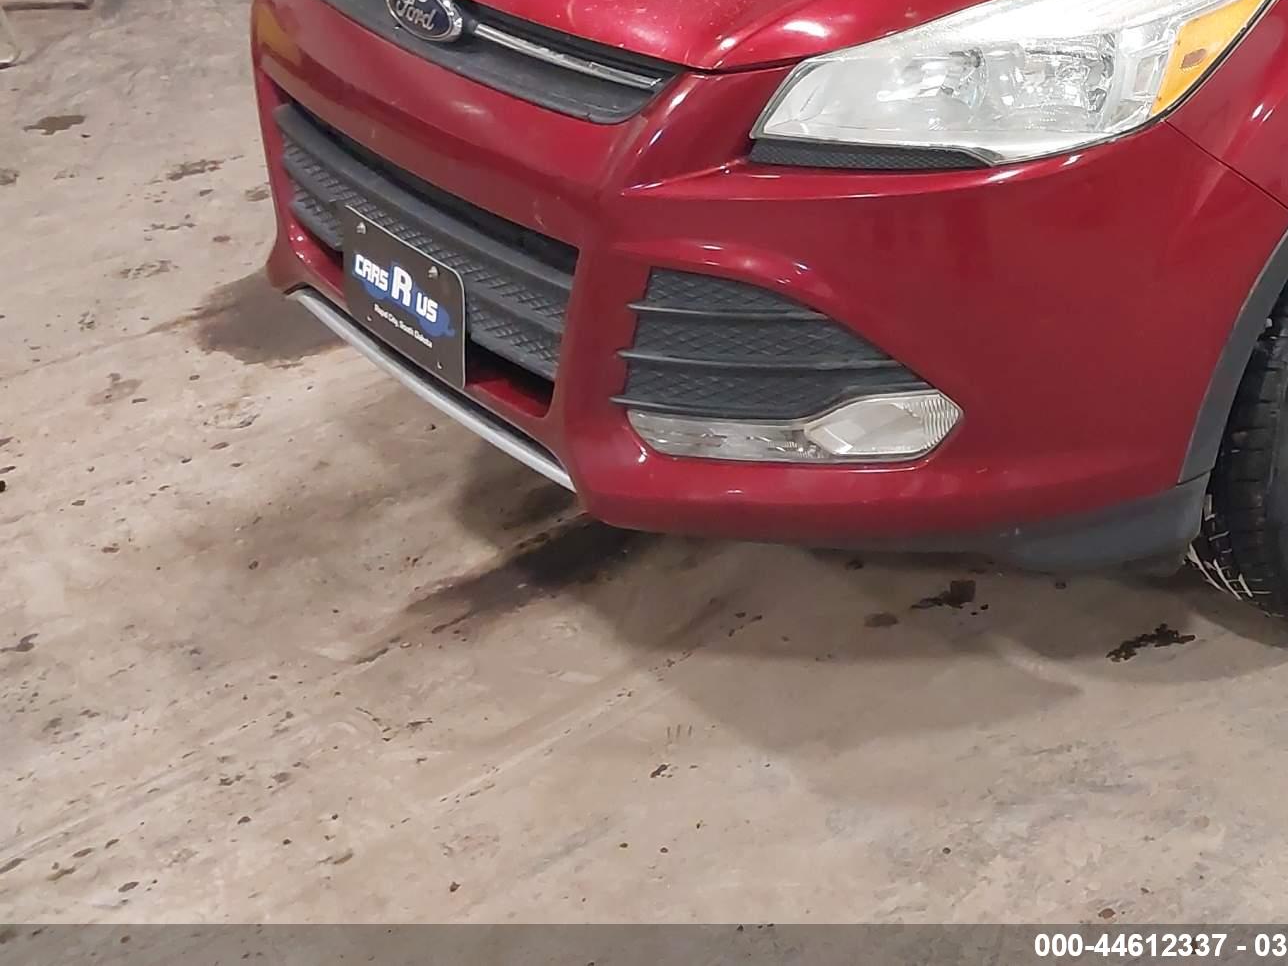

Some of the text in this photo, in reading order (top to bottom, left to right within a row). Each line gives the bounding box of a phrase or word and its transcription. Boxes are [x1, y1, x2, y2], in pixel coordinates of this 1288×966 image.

[354, 254, 438, 323] CARS R US
